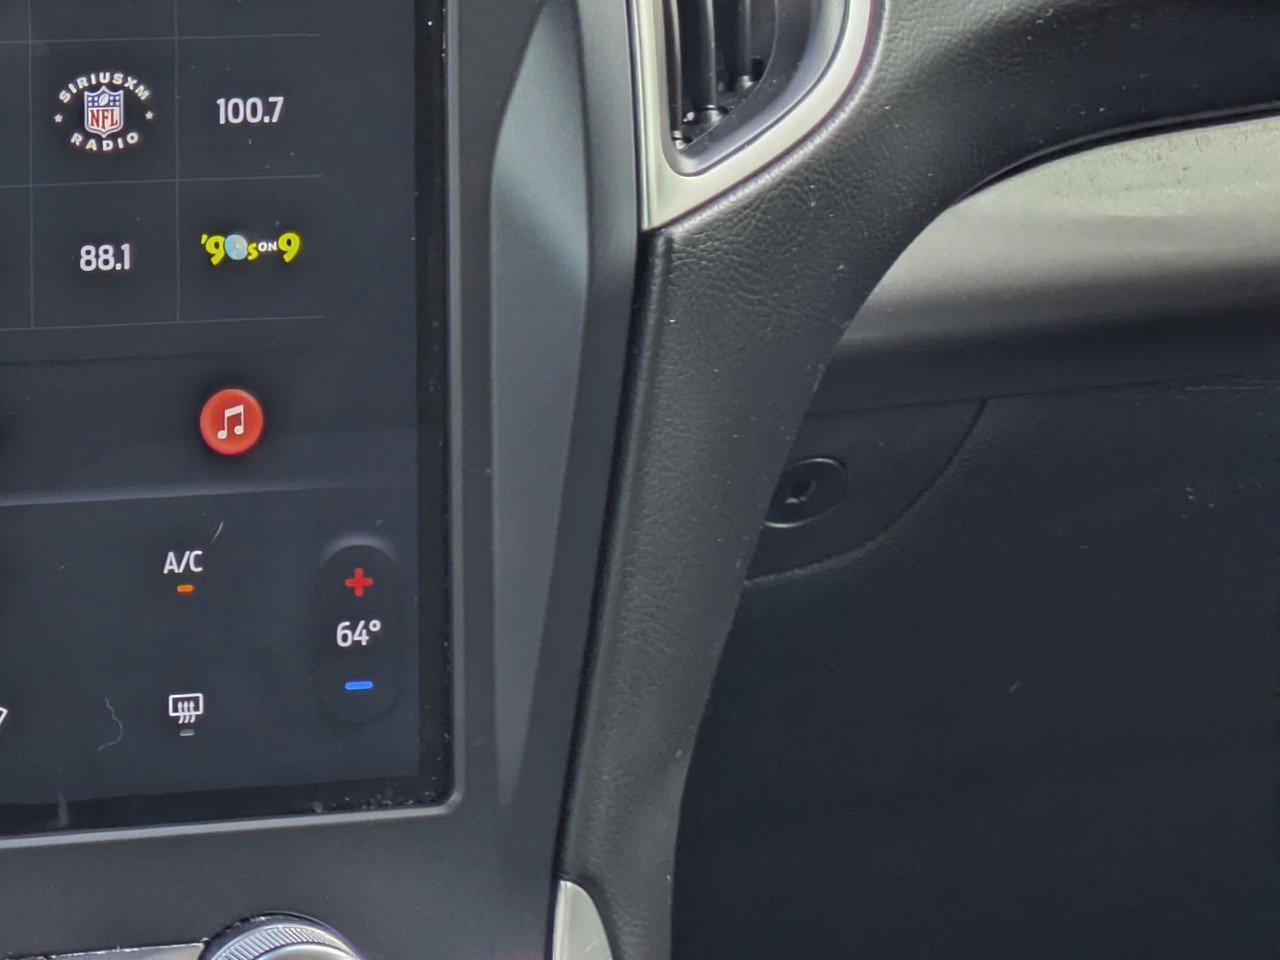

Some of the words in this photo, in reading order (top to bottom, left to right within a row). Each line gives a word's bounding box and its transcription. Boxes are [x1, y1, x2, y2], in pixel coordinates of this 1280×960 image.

[58, 71, 151, 103] SIRIUSXM
[89, 108, 119, 129] NFL
[216, 96, 285, 125] 100.7
[69, 131, 140, 152] RADIO
[78, 243, 131, 272] 88.1
[163, 550, 205, 575] A/C
[335, 619, 383, 648] 64°
